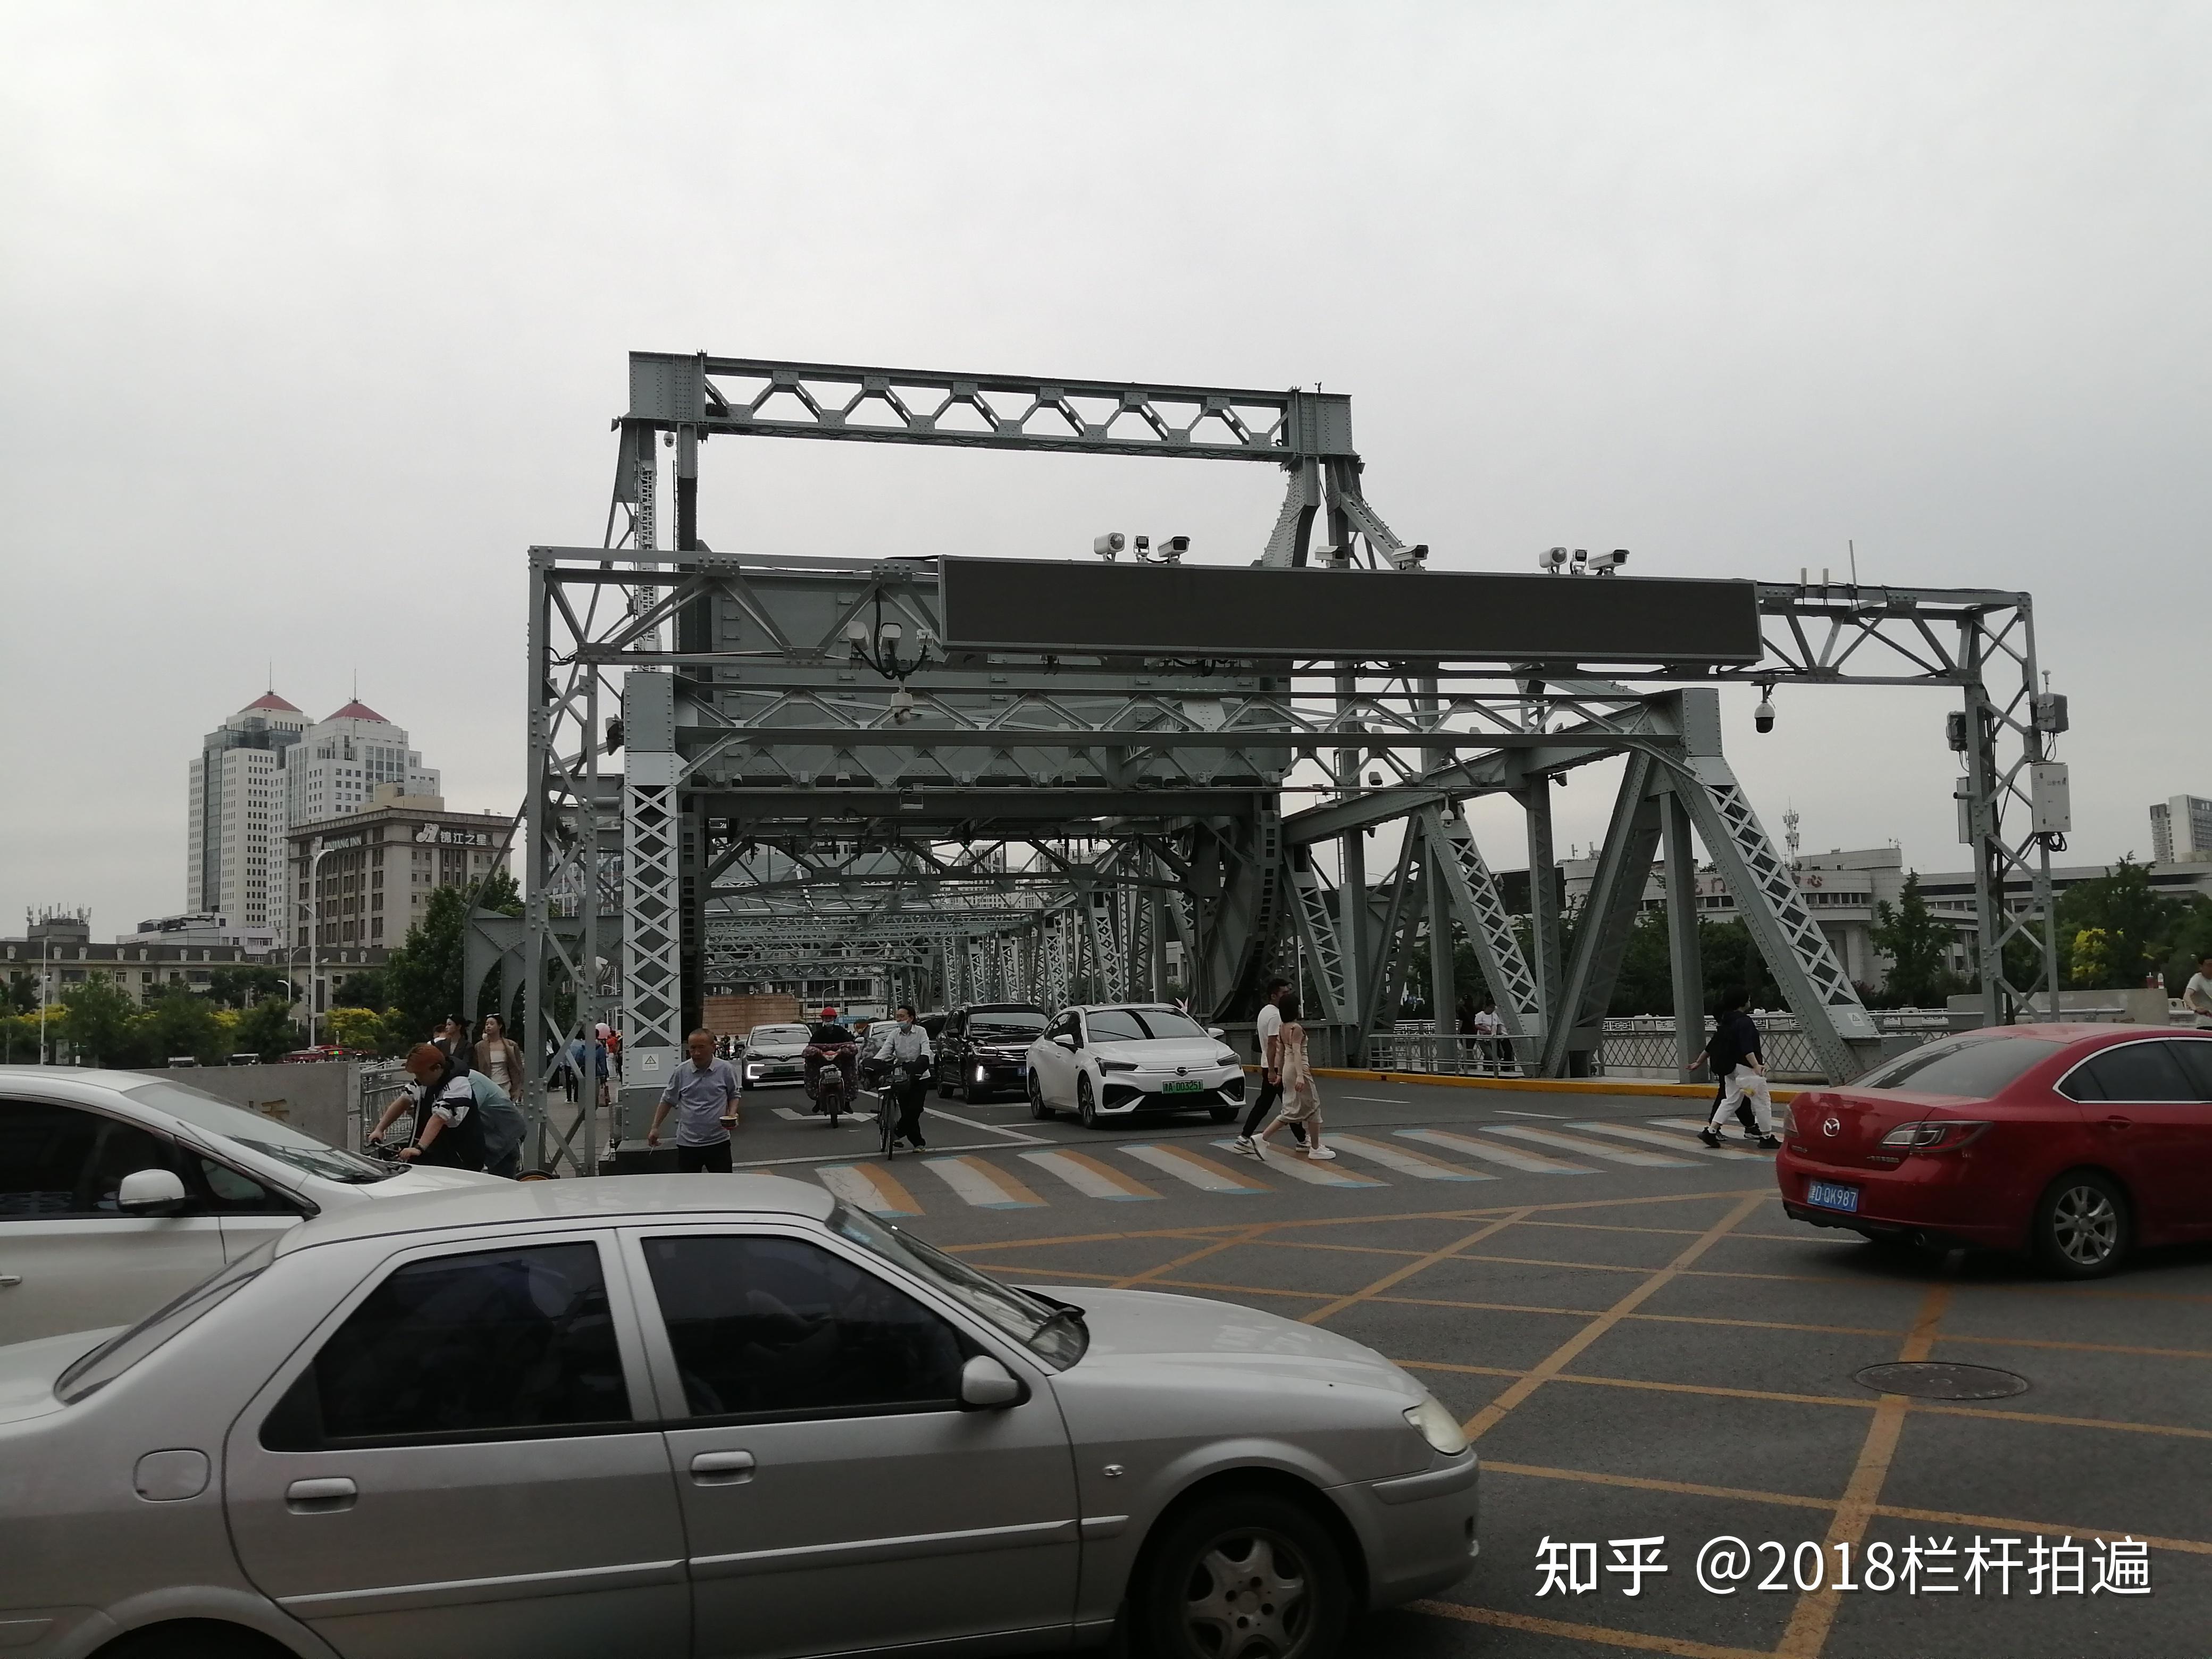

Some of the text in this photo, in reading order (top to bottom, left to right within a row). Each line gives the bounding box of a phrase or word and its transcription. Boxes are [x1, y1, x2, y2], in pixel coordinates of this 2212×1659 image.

[350, 836, 362, 847] INN
[440, 831, 487, 845] 锦江之星
